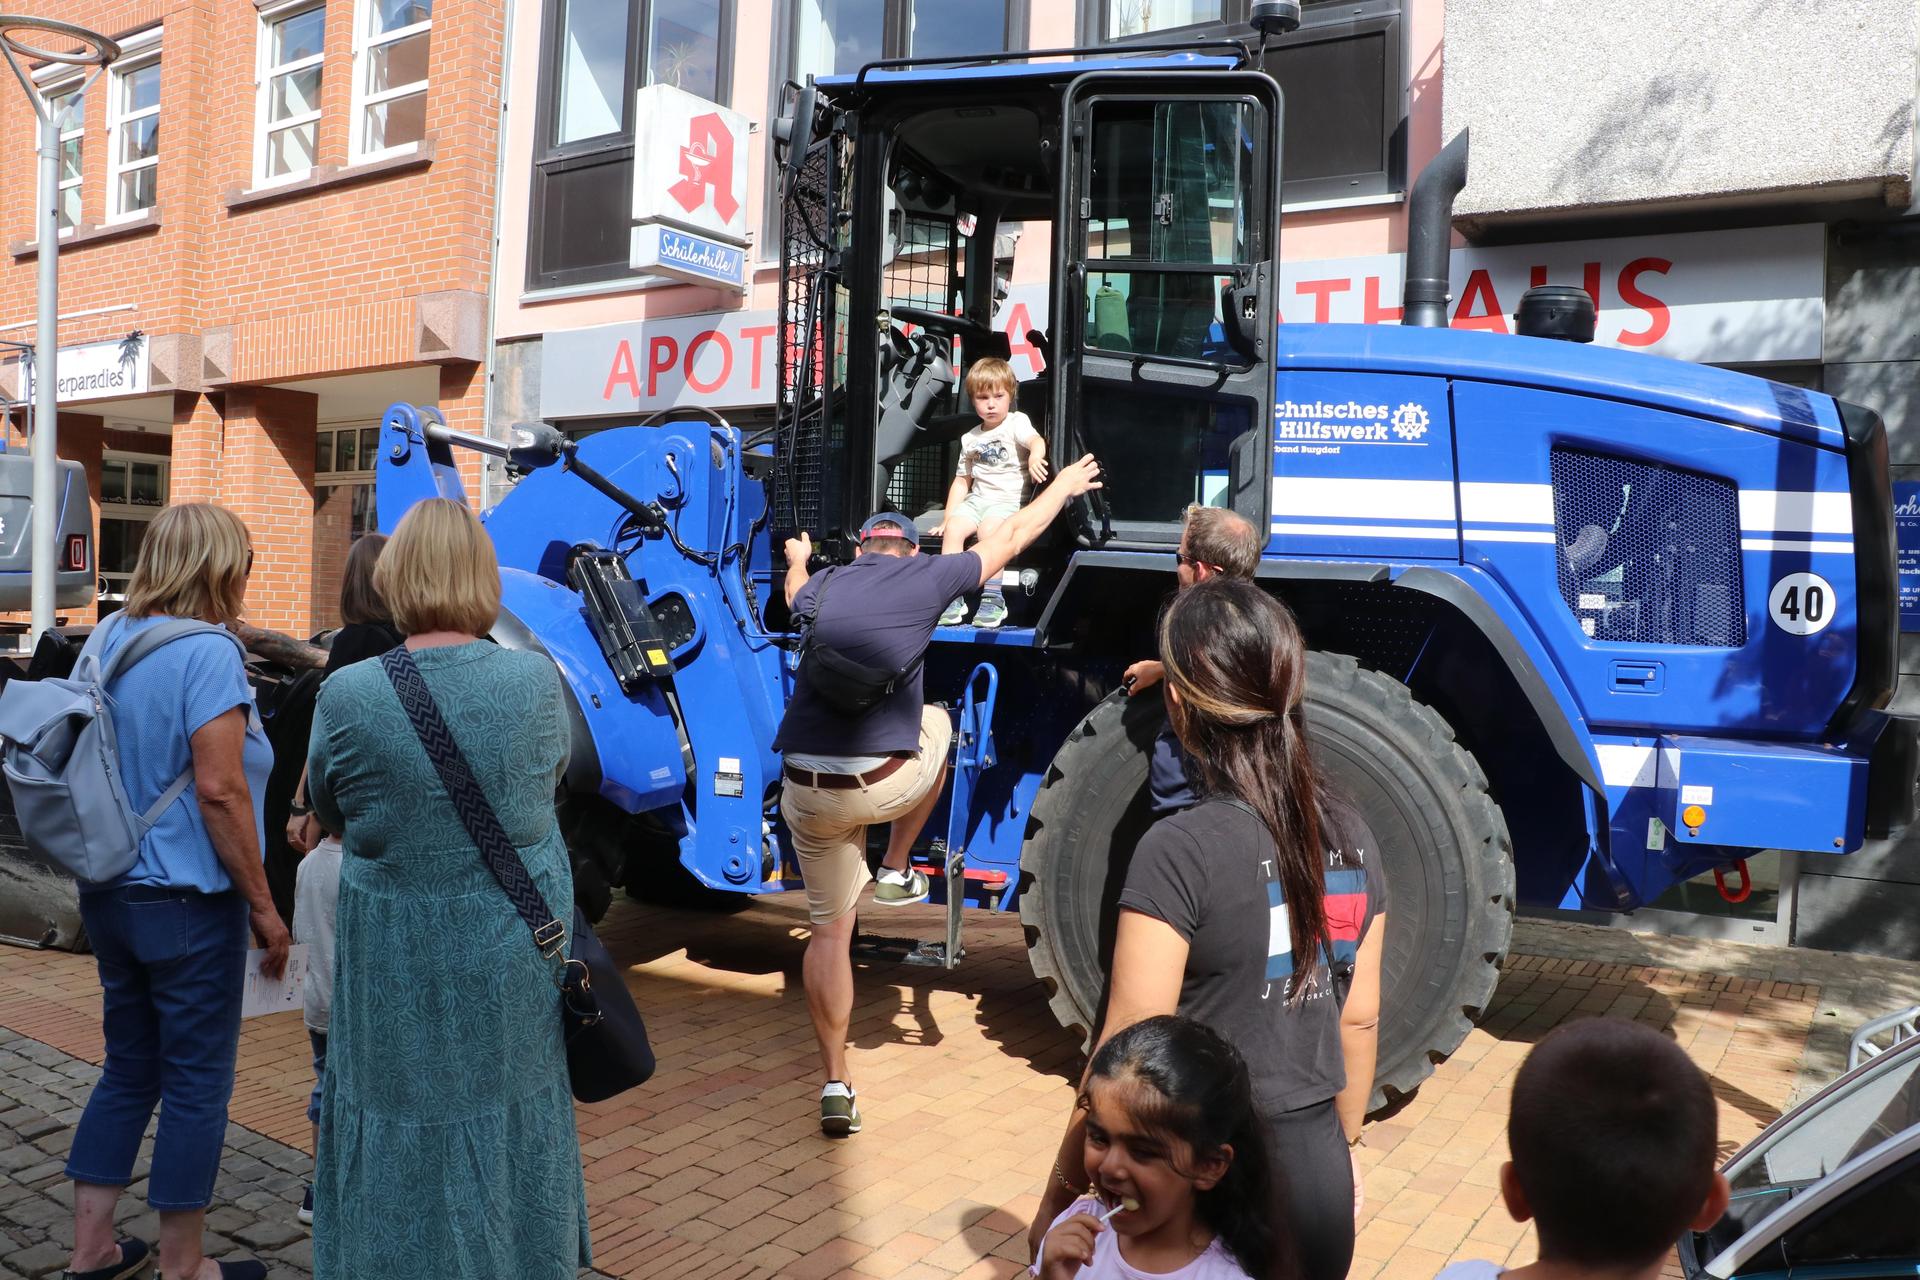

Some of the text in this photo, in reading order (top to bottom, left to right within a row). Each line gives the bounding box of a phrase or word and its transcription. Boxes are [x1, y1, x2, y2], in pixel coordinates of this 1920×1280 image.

[1275, 401, 1389, 419] chnisches
[1280, 421, 1388, 440] Hilfswerk
[1301, 445, 1341, 455] Burgdorf
[1781, 586, 1823, 622] 40
[1261, 848, 1365, 878] TMY
